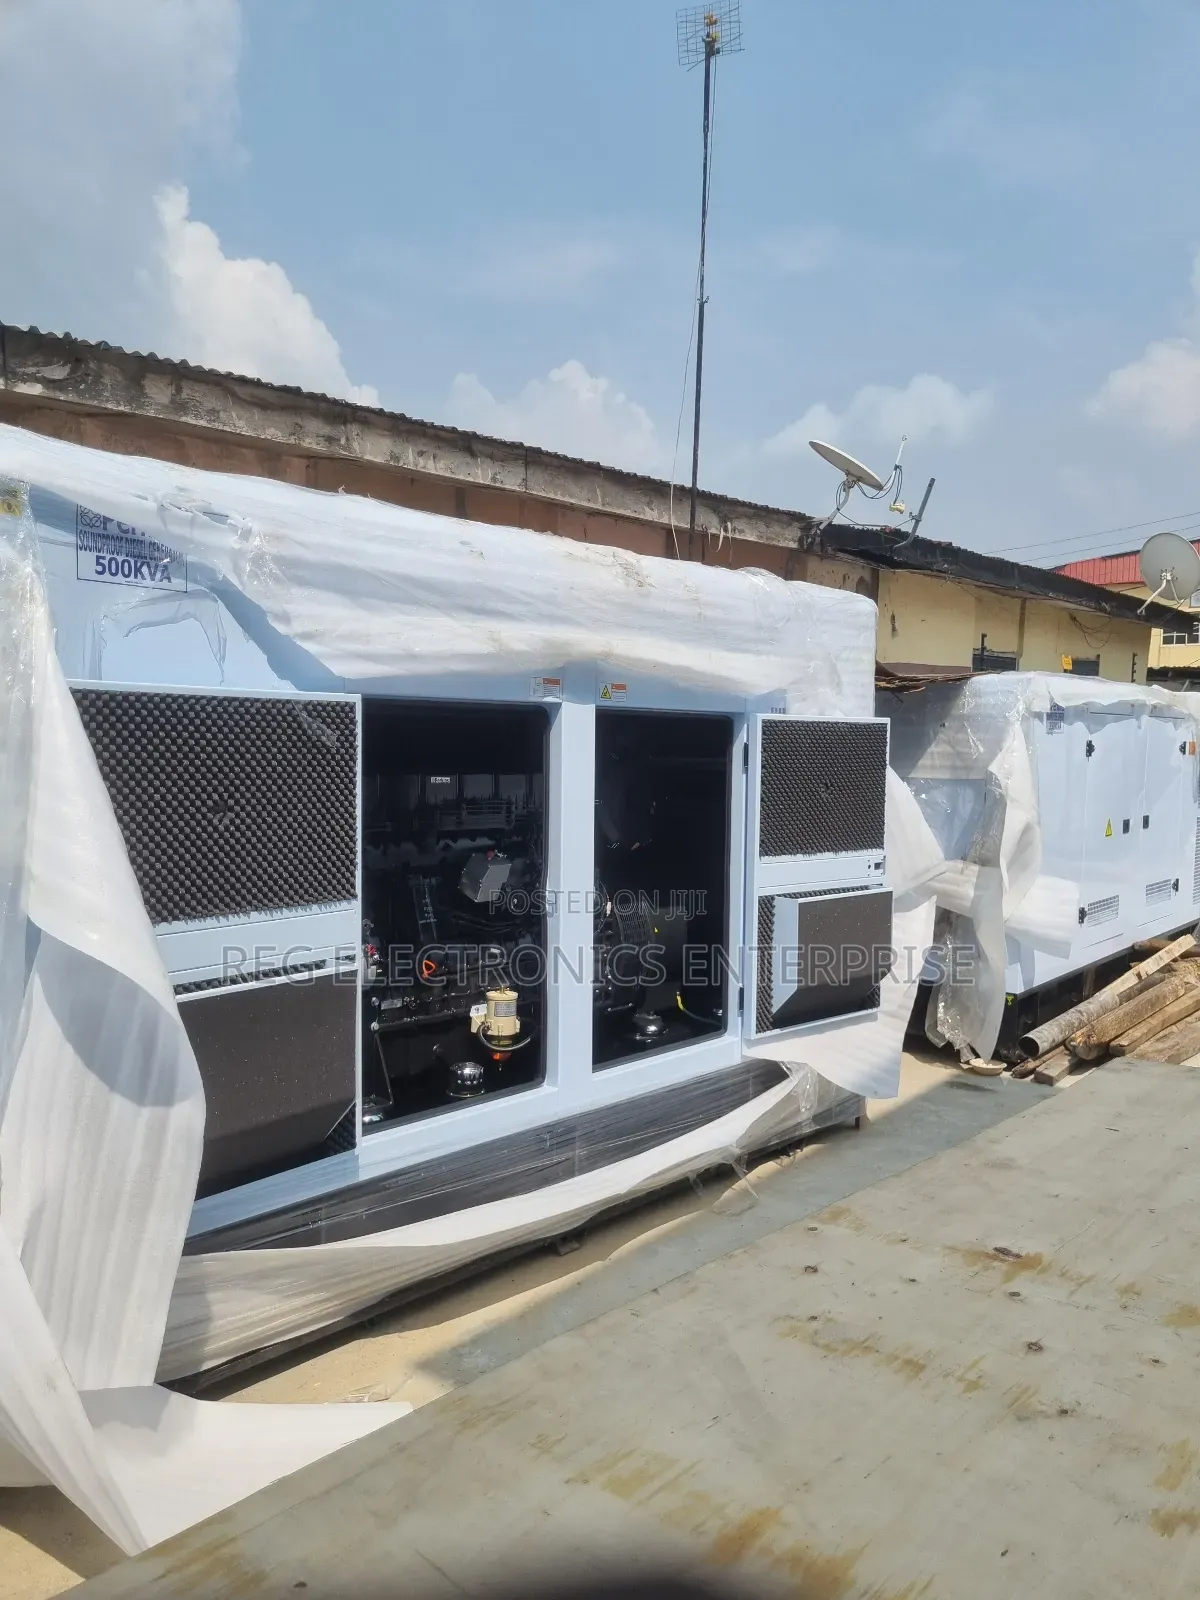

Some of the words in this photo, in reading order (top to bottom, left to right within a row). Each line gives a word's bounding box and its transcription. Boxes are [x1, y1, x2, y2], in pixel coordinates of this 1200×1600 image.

[79, 530, 124, 556] SOUNDPROOF
[125, 538, 148, 561] DIESEL
[94, 554, 172, 584] 500KVA
